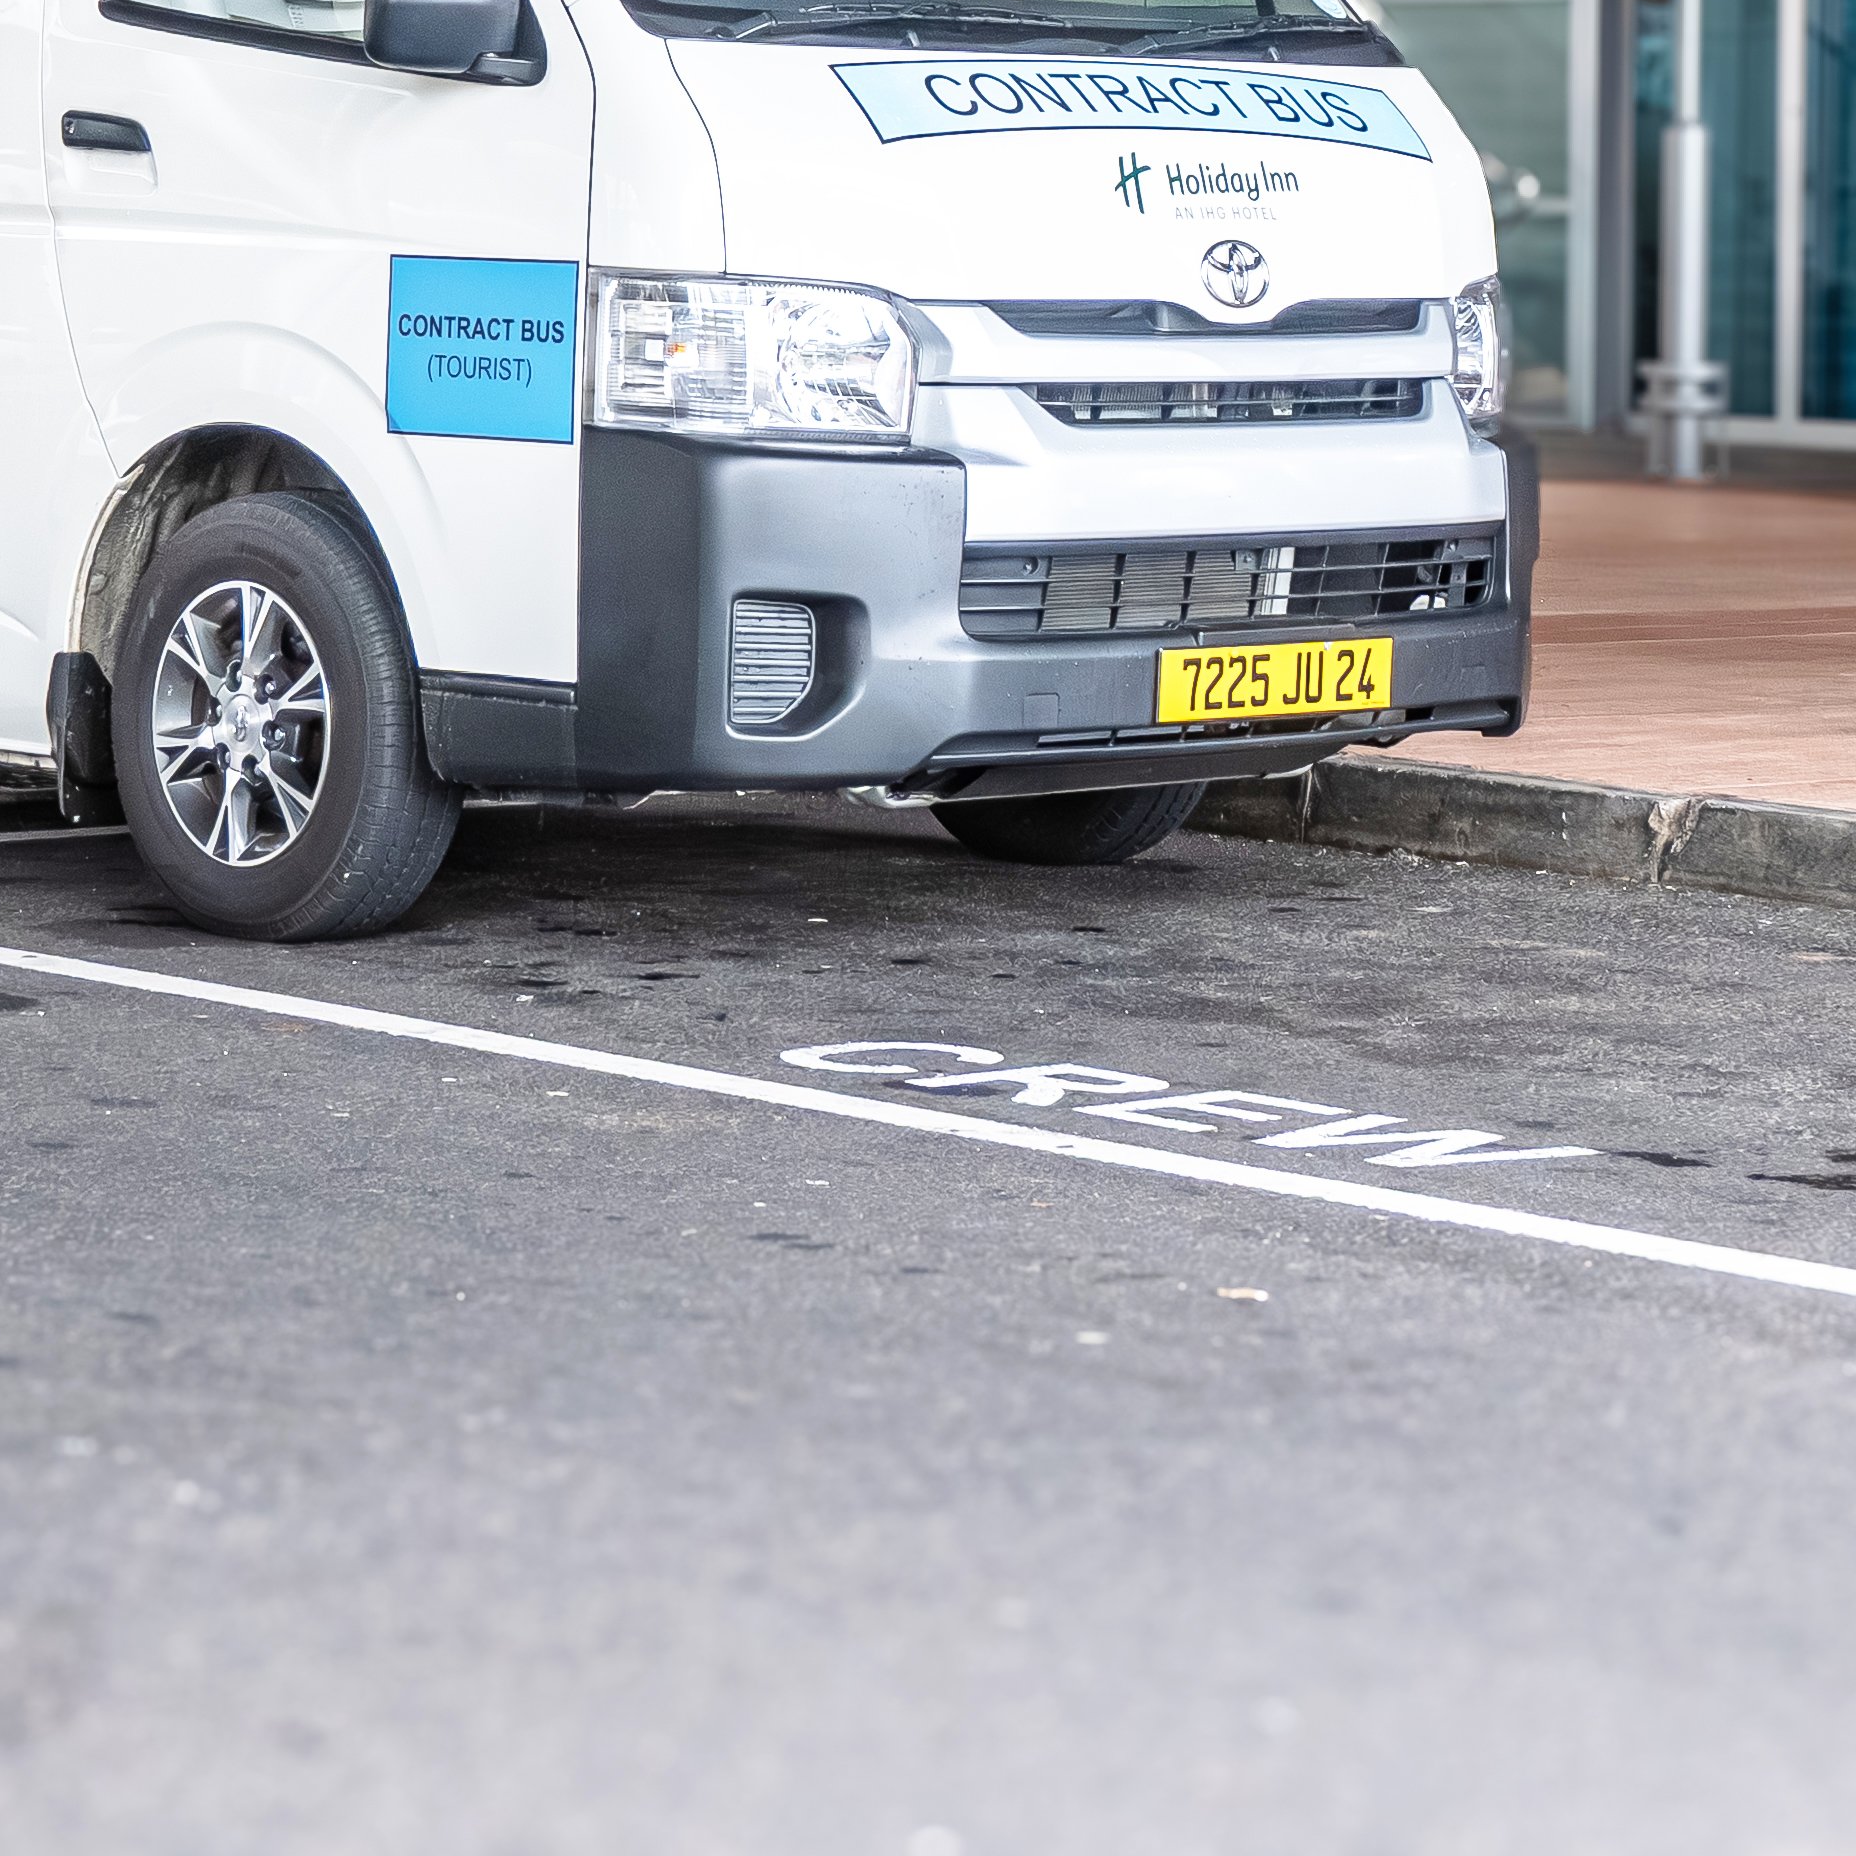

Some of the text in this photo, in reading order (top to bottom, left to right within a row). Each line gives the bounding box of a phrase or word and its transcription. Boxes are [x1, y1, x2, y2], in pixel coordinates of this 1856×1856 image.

[924, 72, 1369, 133] CONTRACT BUS
[1175, 206, 1278, 221] AN IHG HOTEL
[397, 313, 565, 344] CONTRACT BUS
[427, 354, 533, 388] (TOURIST)
[1182, 648, 1375, 712] 7225 JU 24
[778, 1039, 1607, 1169] CREW
